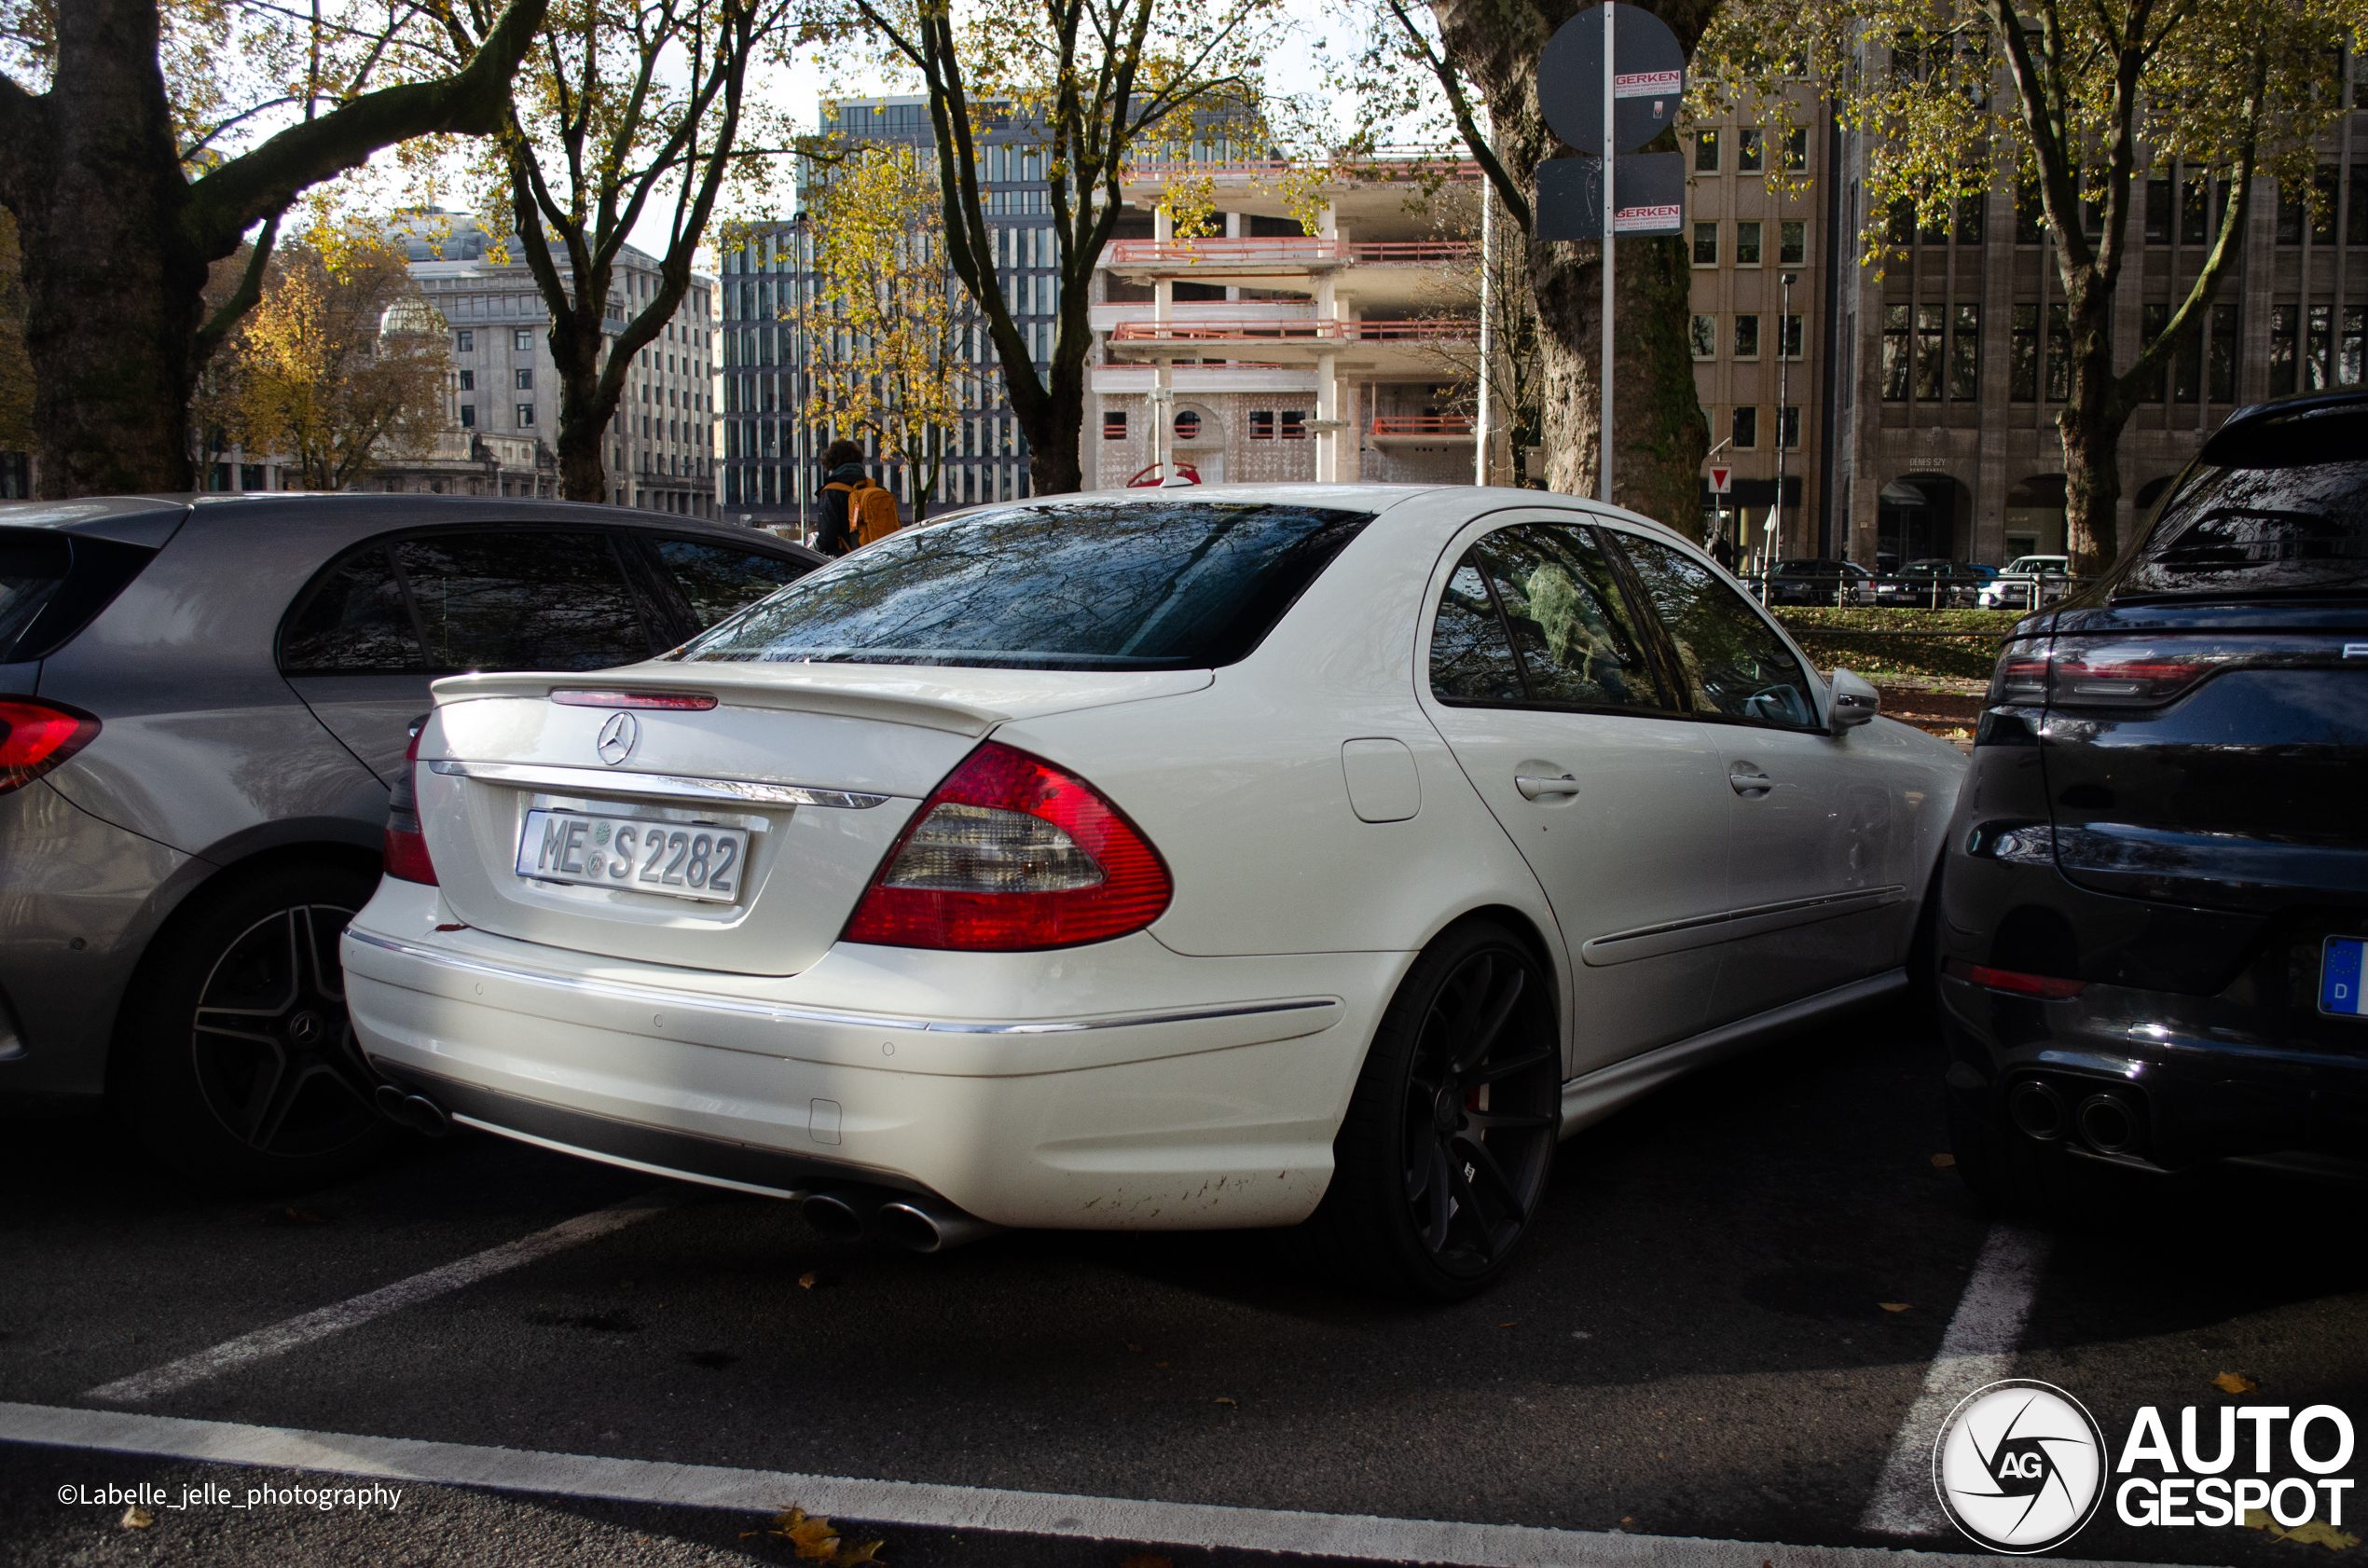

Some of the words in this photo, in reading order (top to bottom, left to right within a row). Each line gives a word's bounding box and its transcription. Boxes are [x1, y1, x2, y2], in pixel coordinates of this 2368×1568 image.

[1616, 72, 1679, 85] GERKEN
[1616, 207, 1678, 218] GERKEN
[1933, 458, 1946, 466] SZY
[538, 818, 589, 873] ME
[609, 826, 638, 878] S
[639, 830, 737, 891] 2282
[2334, 983, 2347, 999] D
